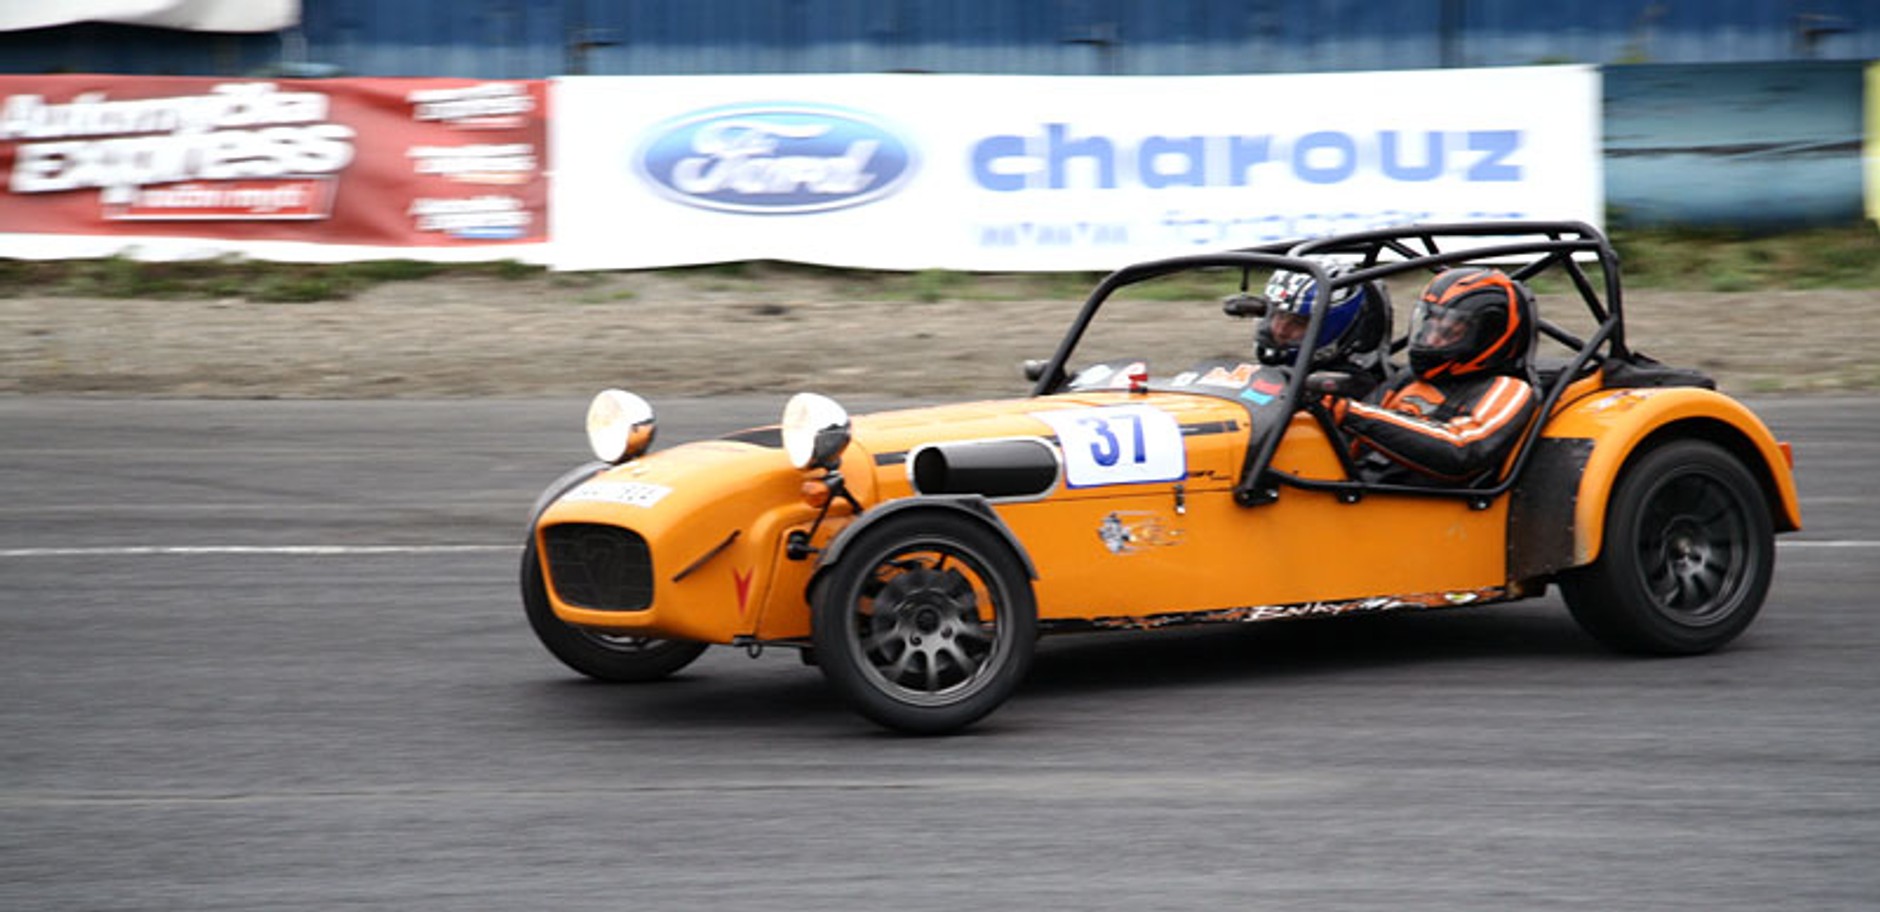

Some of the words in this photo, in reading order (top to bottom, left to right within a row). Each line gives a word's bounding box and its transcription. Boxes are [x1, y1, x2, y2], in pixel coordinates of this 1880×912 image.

[671, 118, 880, 194] Ford
[969, 123, 1525, 192] charouz
[1077, 413, 1147, 467] 37
